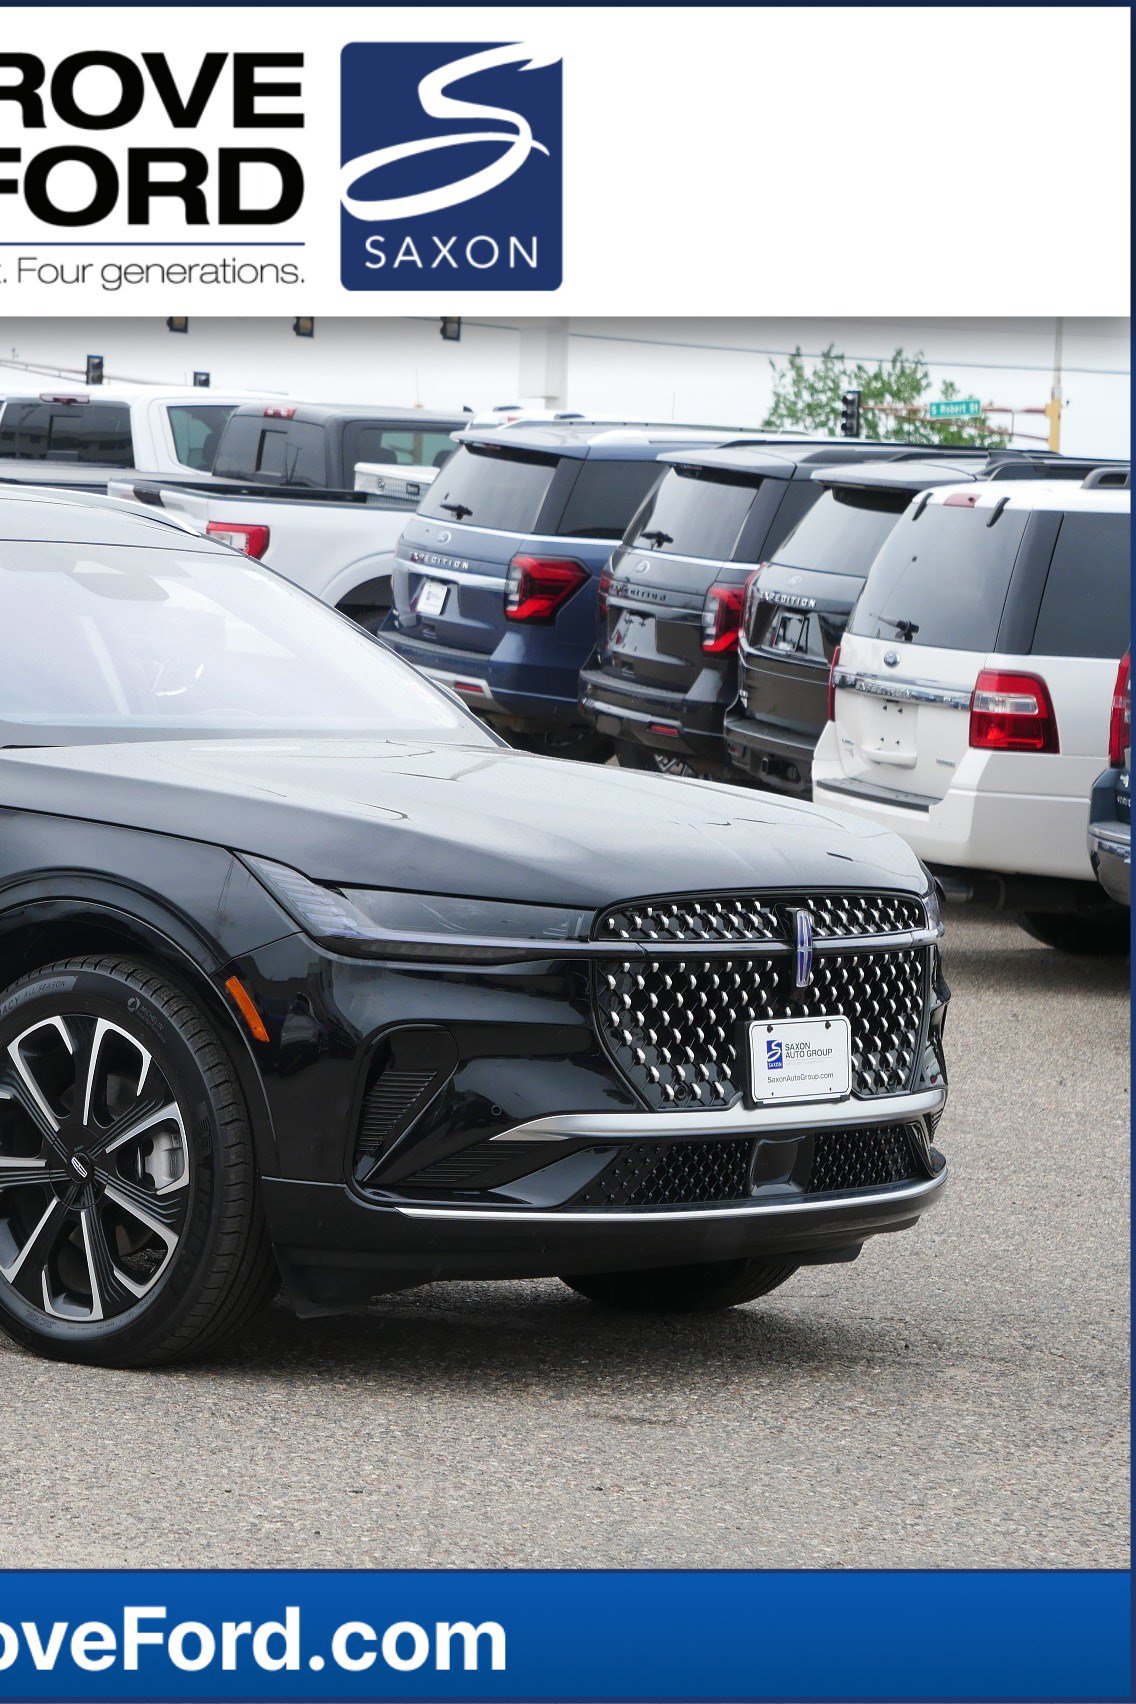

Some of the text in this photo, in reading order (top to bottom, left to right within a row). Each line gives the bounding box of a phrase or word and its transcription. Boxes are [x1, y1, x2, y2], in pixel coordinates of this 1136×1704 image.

[760, 591, 817, 608] EXPEDITION
[785, 1042, 810, 1051] SAXON
[785, 1049, 833, 1059] AUTO GROUP
[768, 1073, 833, 1083] SaxonAutoGroup.com
